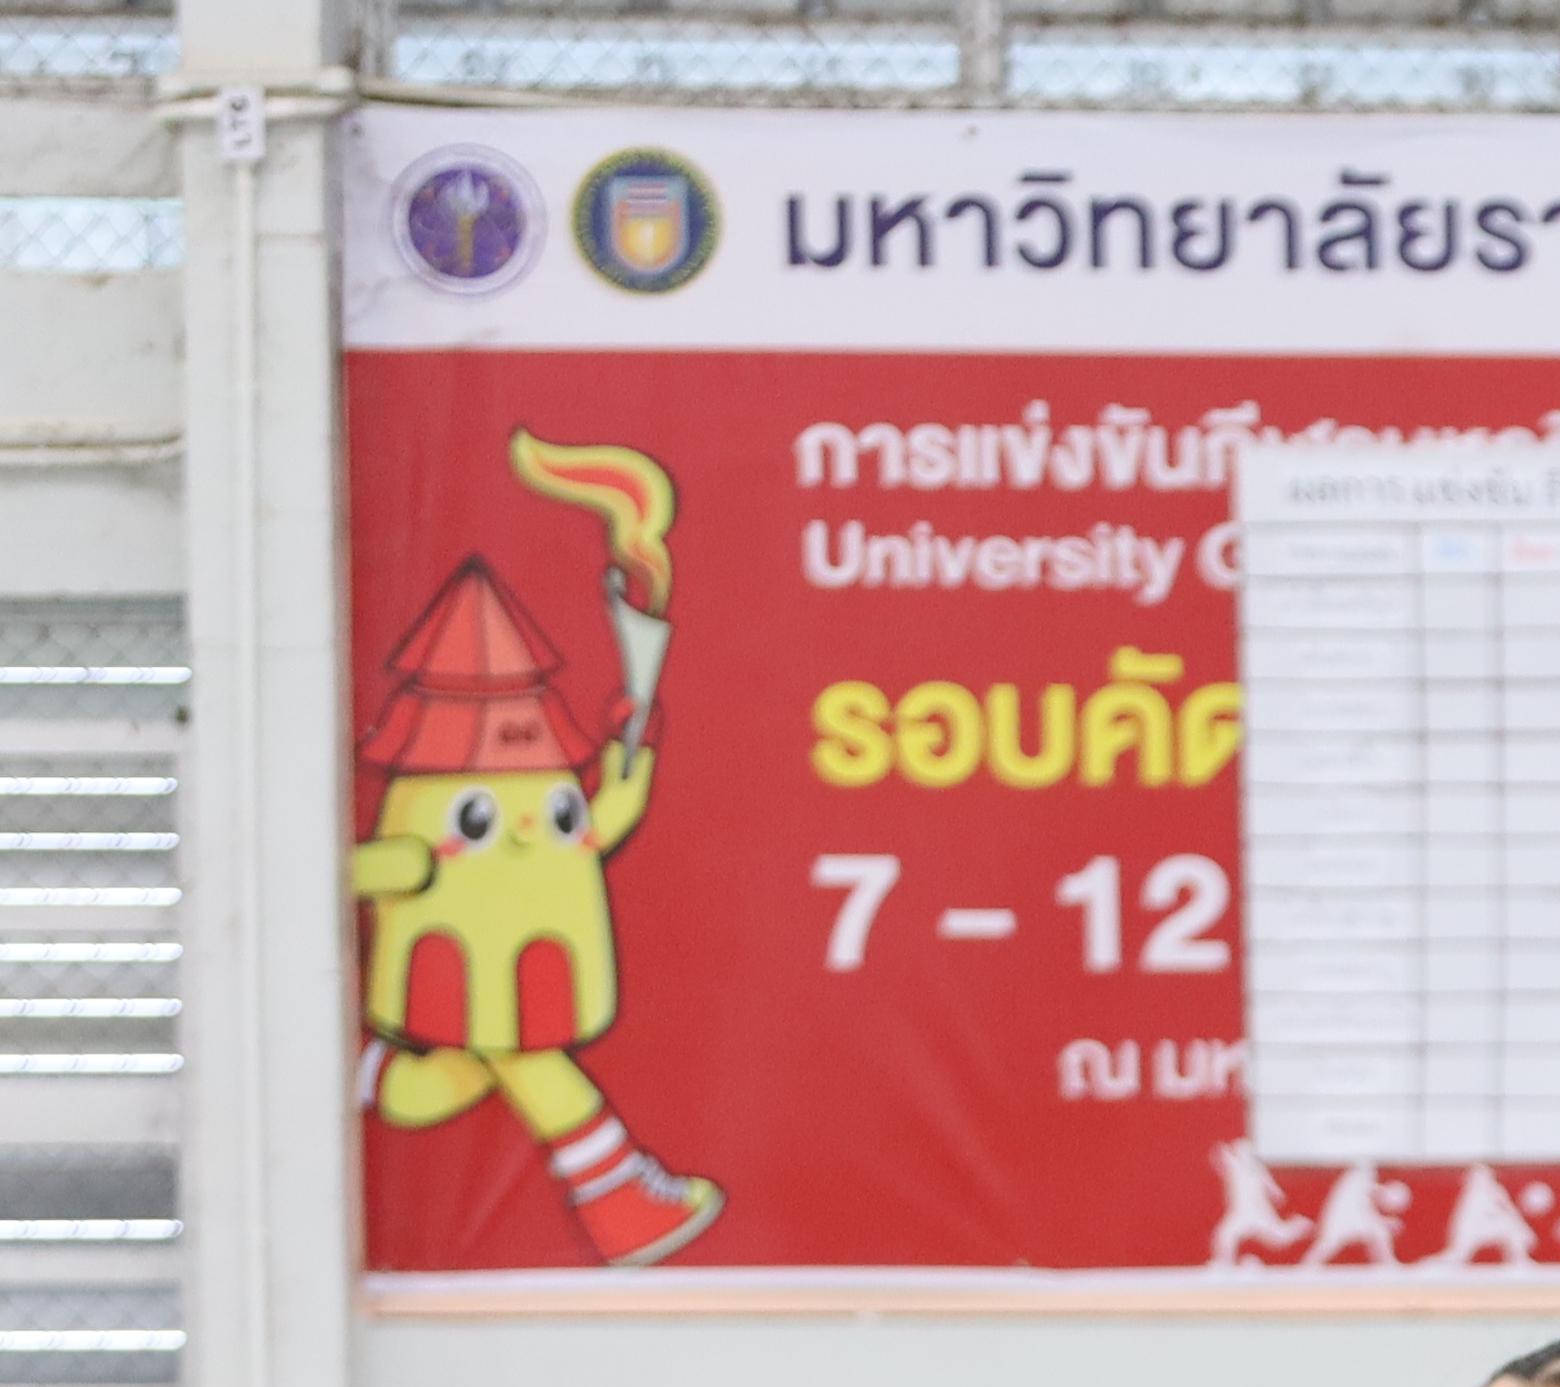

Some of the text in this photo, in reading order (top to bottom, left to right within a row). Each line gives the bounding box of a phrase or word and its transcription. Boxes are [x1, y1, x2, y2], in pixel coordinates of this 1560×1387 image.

[805, 518, 1184, 602] University
[811, 646, 1242, 789] รอบคัด
[810, 853, 901, 972] 7
[1055, 853, 1231, 974] 12
[1058, 1037, 1140, 1101] ณ
